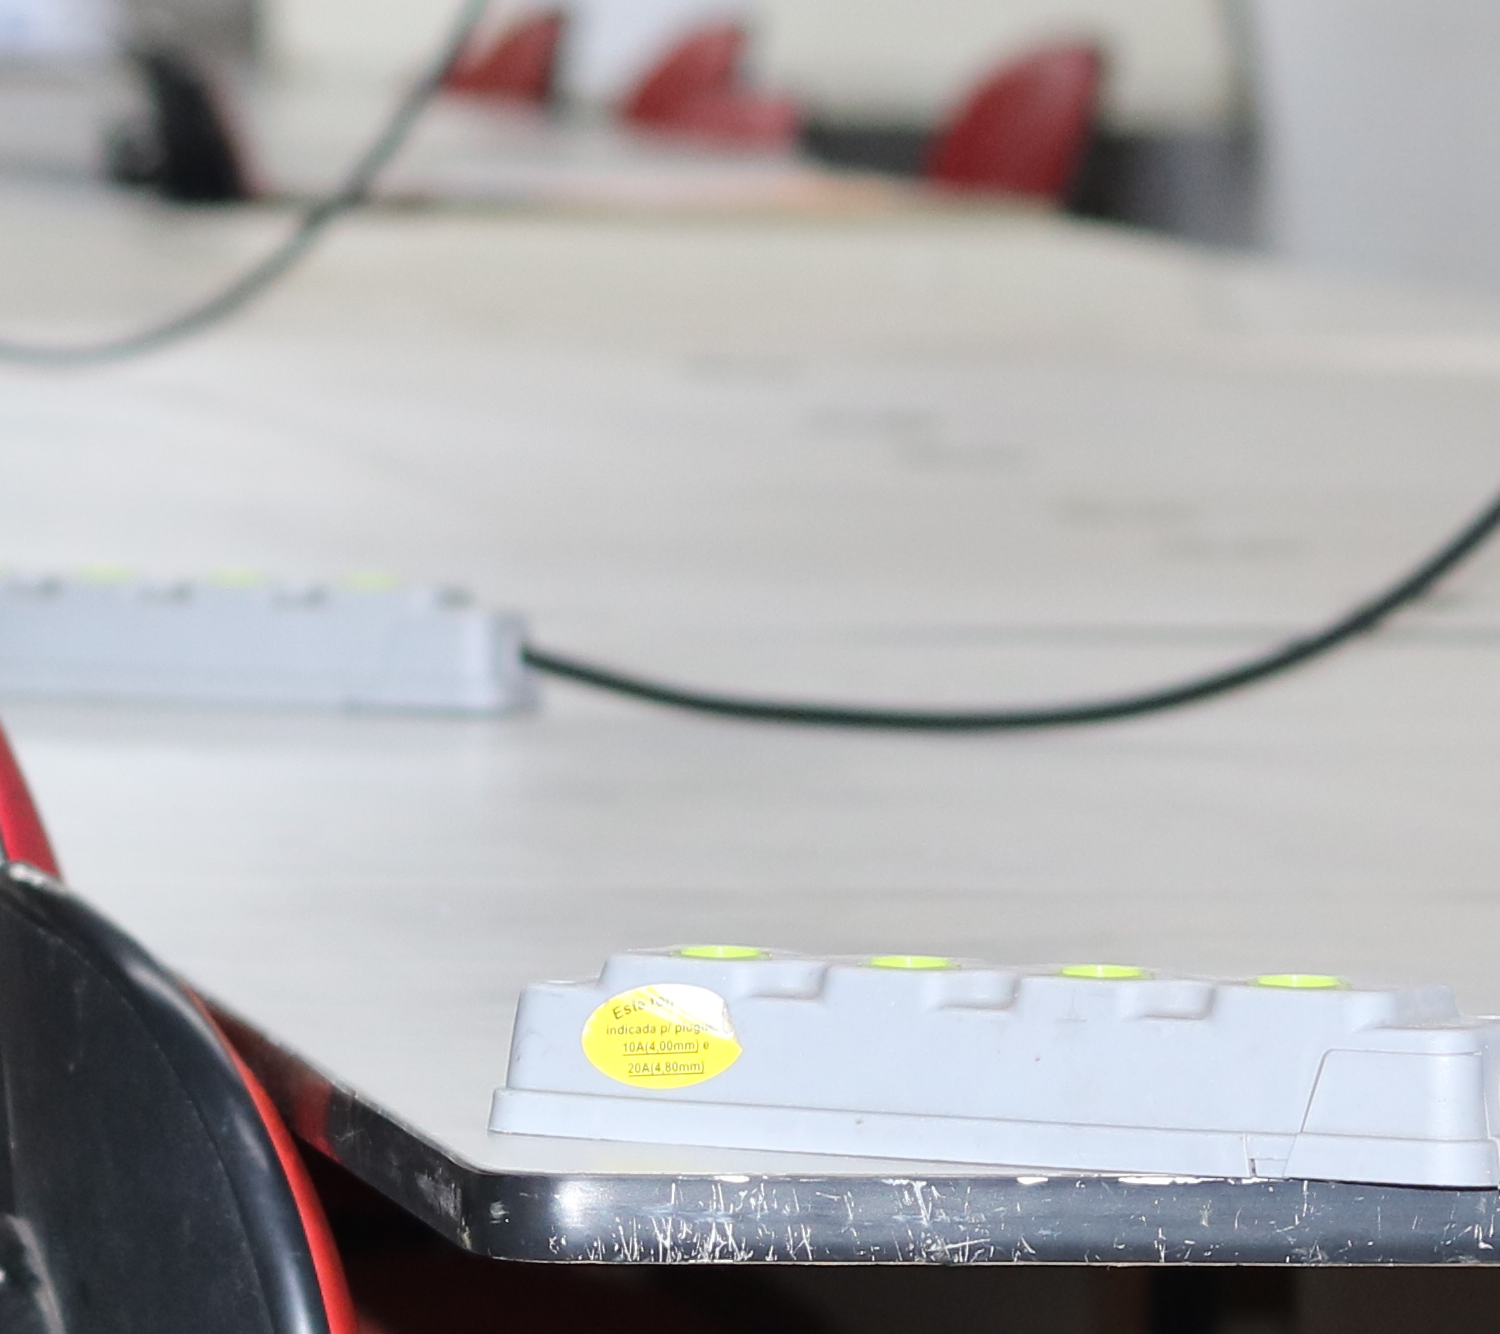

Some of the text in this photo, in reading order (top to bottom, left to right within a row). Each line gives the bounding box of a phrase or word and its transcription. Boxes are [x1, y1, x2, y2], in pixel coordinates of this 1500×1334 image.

[606, 1022, 657, 1036] indicada
[660, 1022, 672, 1037] p/
[623, 1040, 710, 1054] 10A(4,00mm) e
[628, 1061, 705, 1075] 20A(4,80mm)
